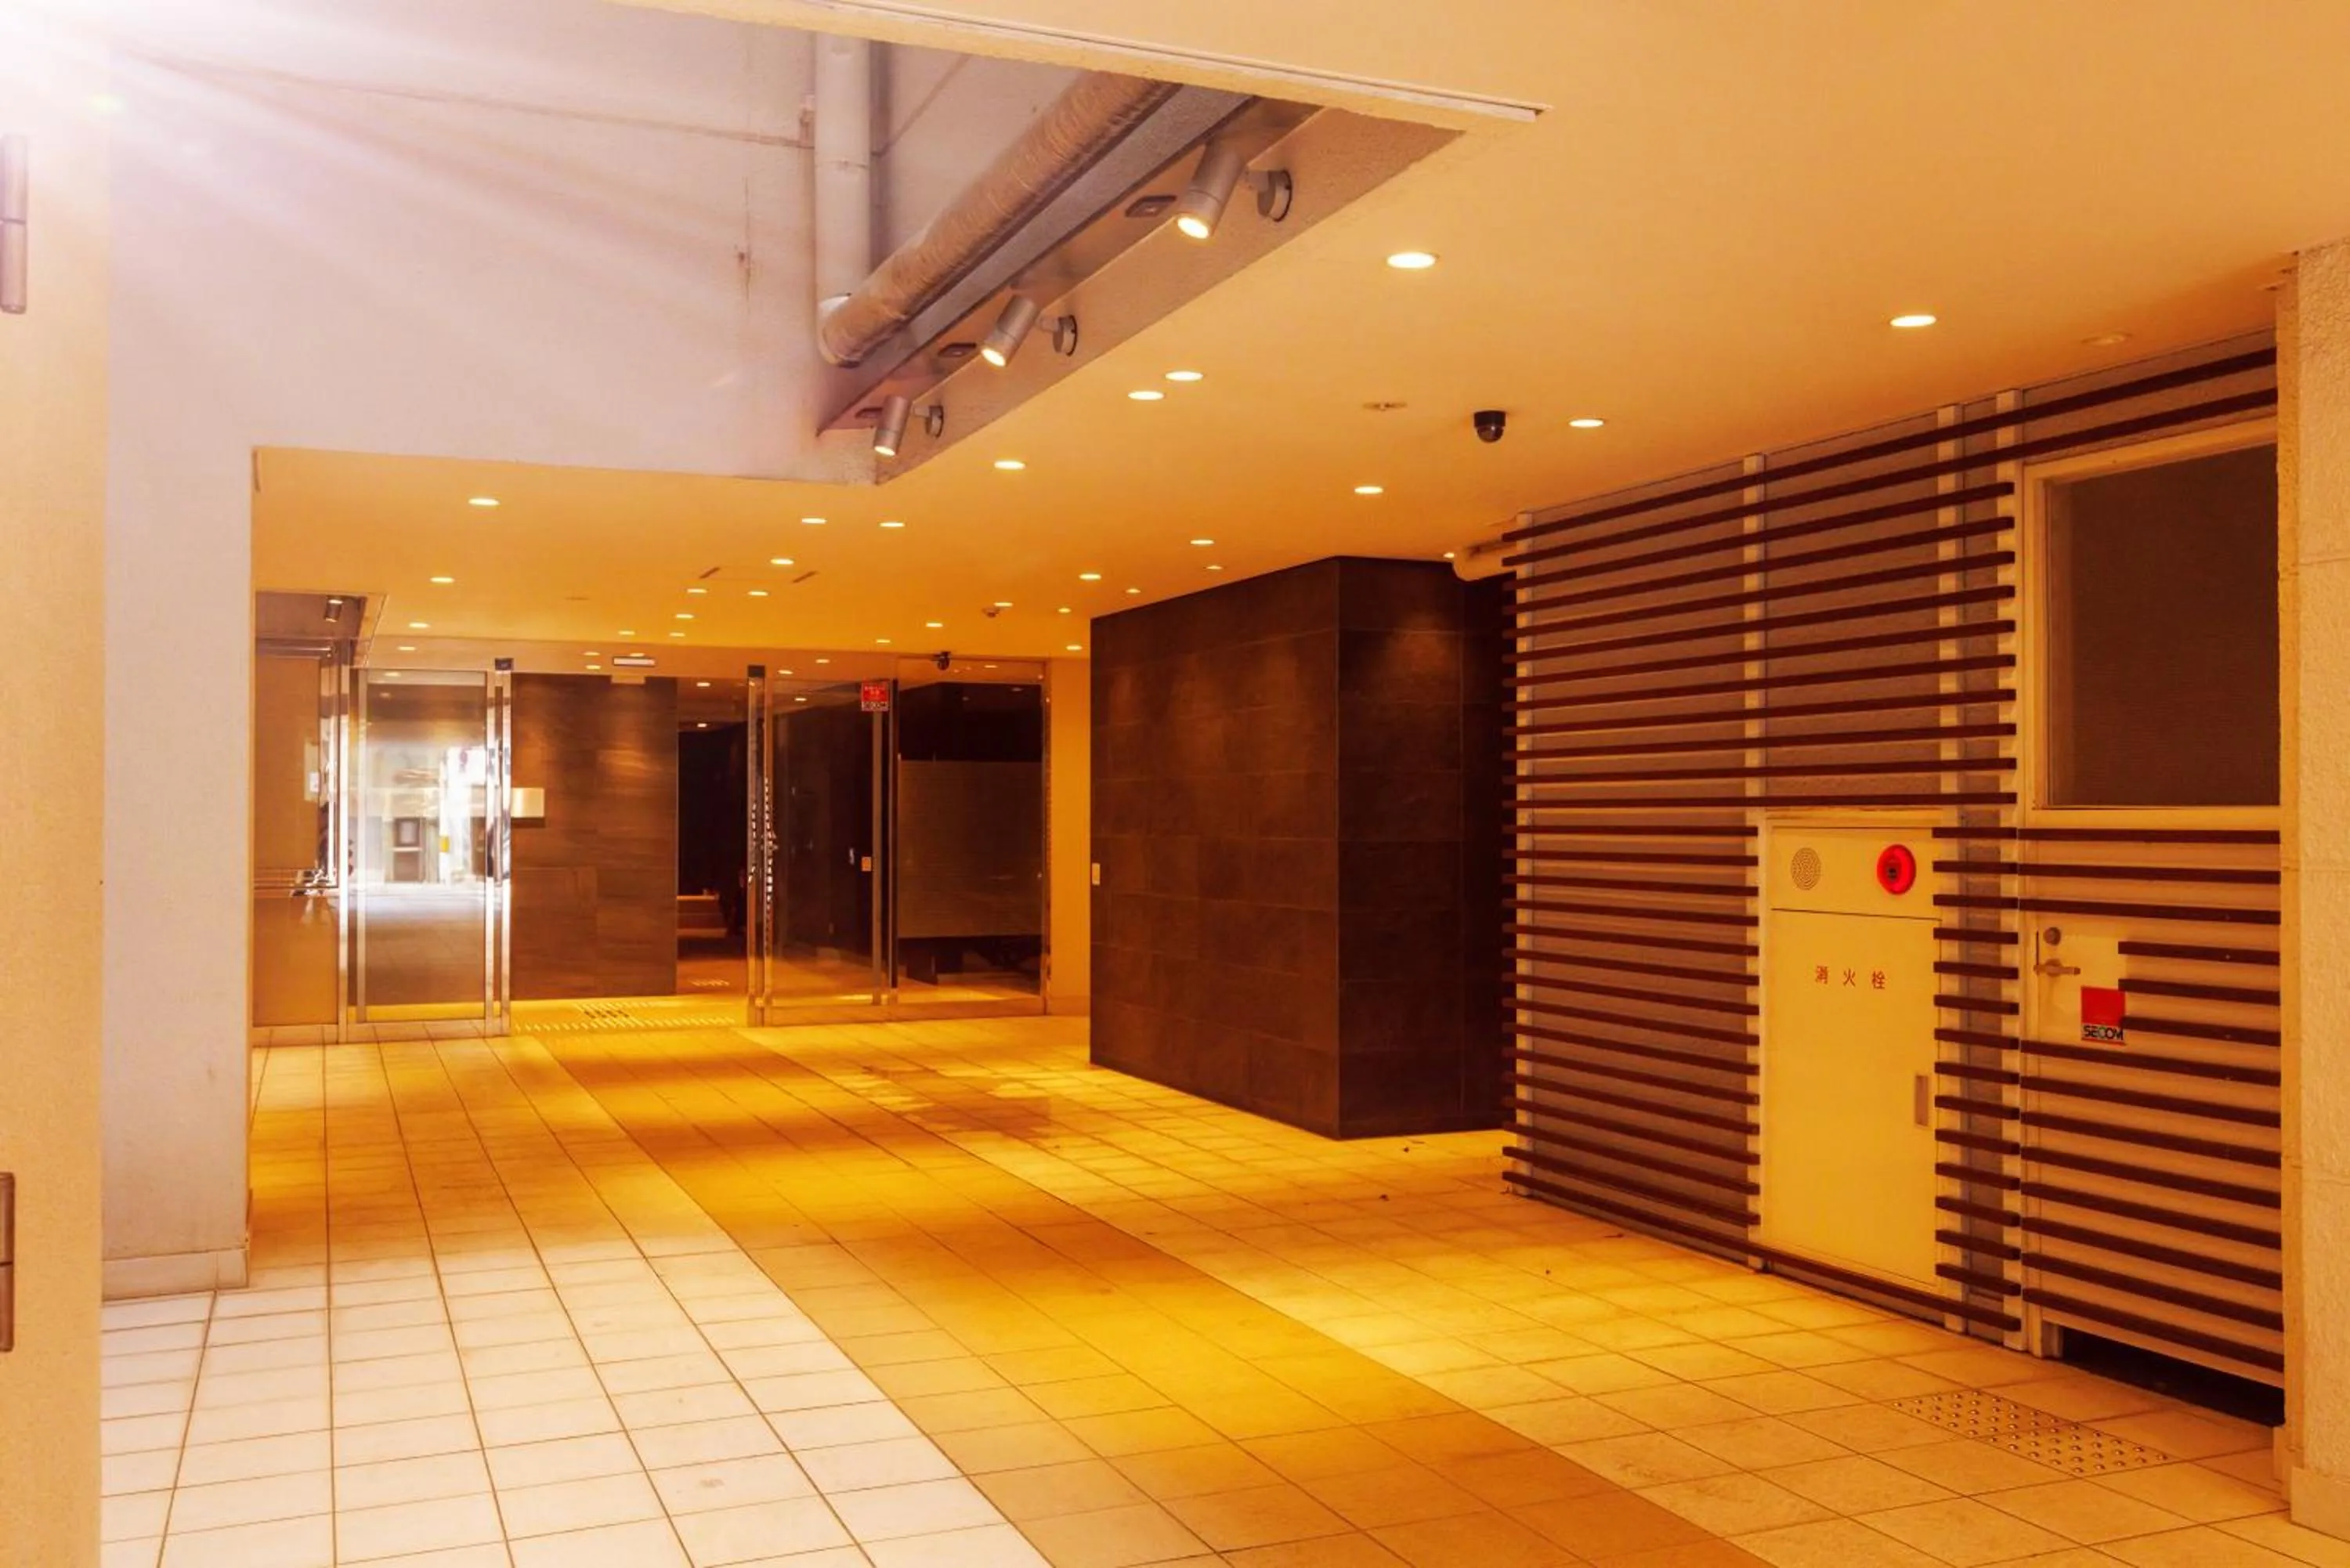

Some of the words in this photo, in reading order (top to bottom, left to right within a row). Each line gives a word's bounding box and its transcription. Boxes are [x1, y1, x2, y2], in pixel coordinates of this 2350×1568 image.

[1815, 965, 1886, 990] 消火栓
[2083, 1025, 2124, 1041] SECOM
